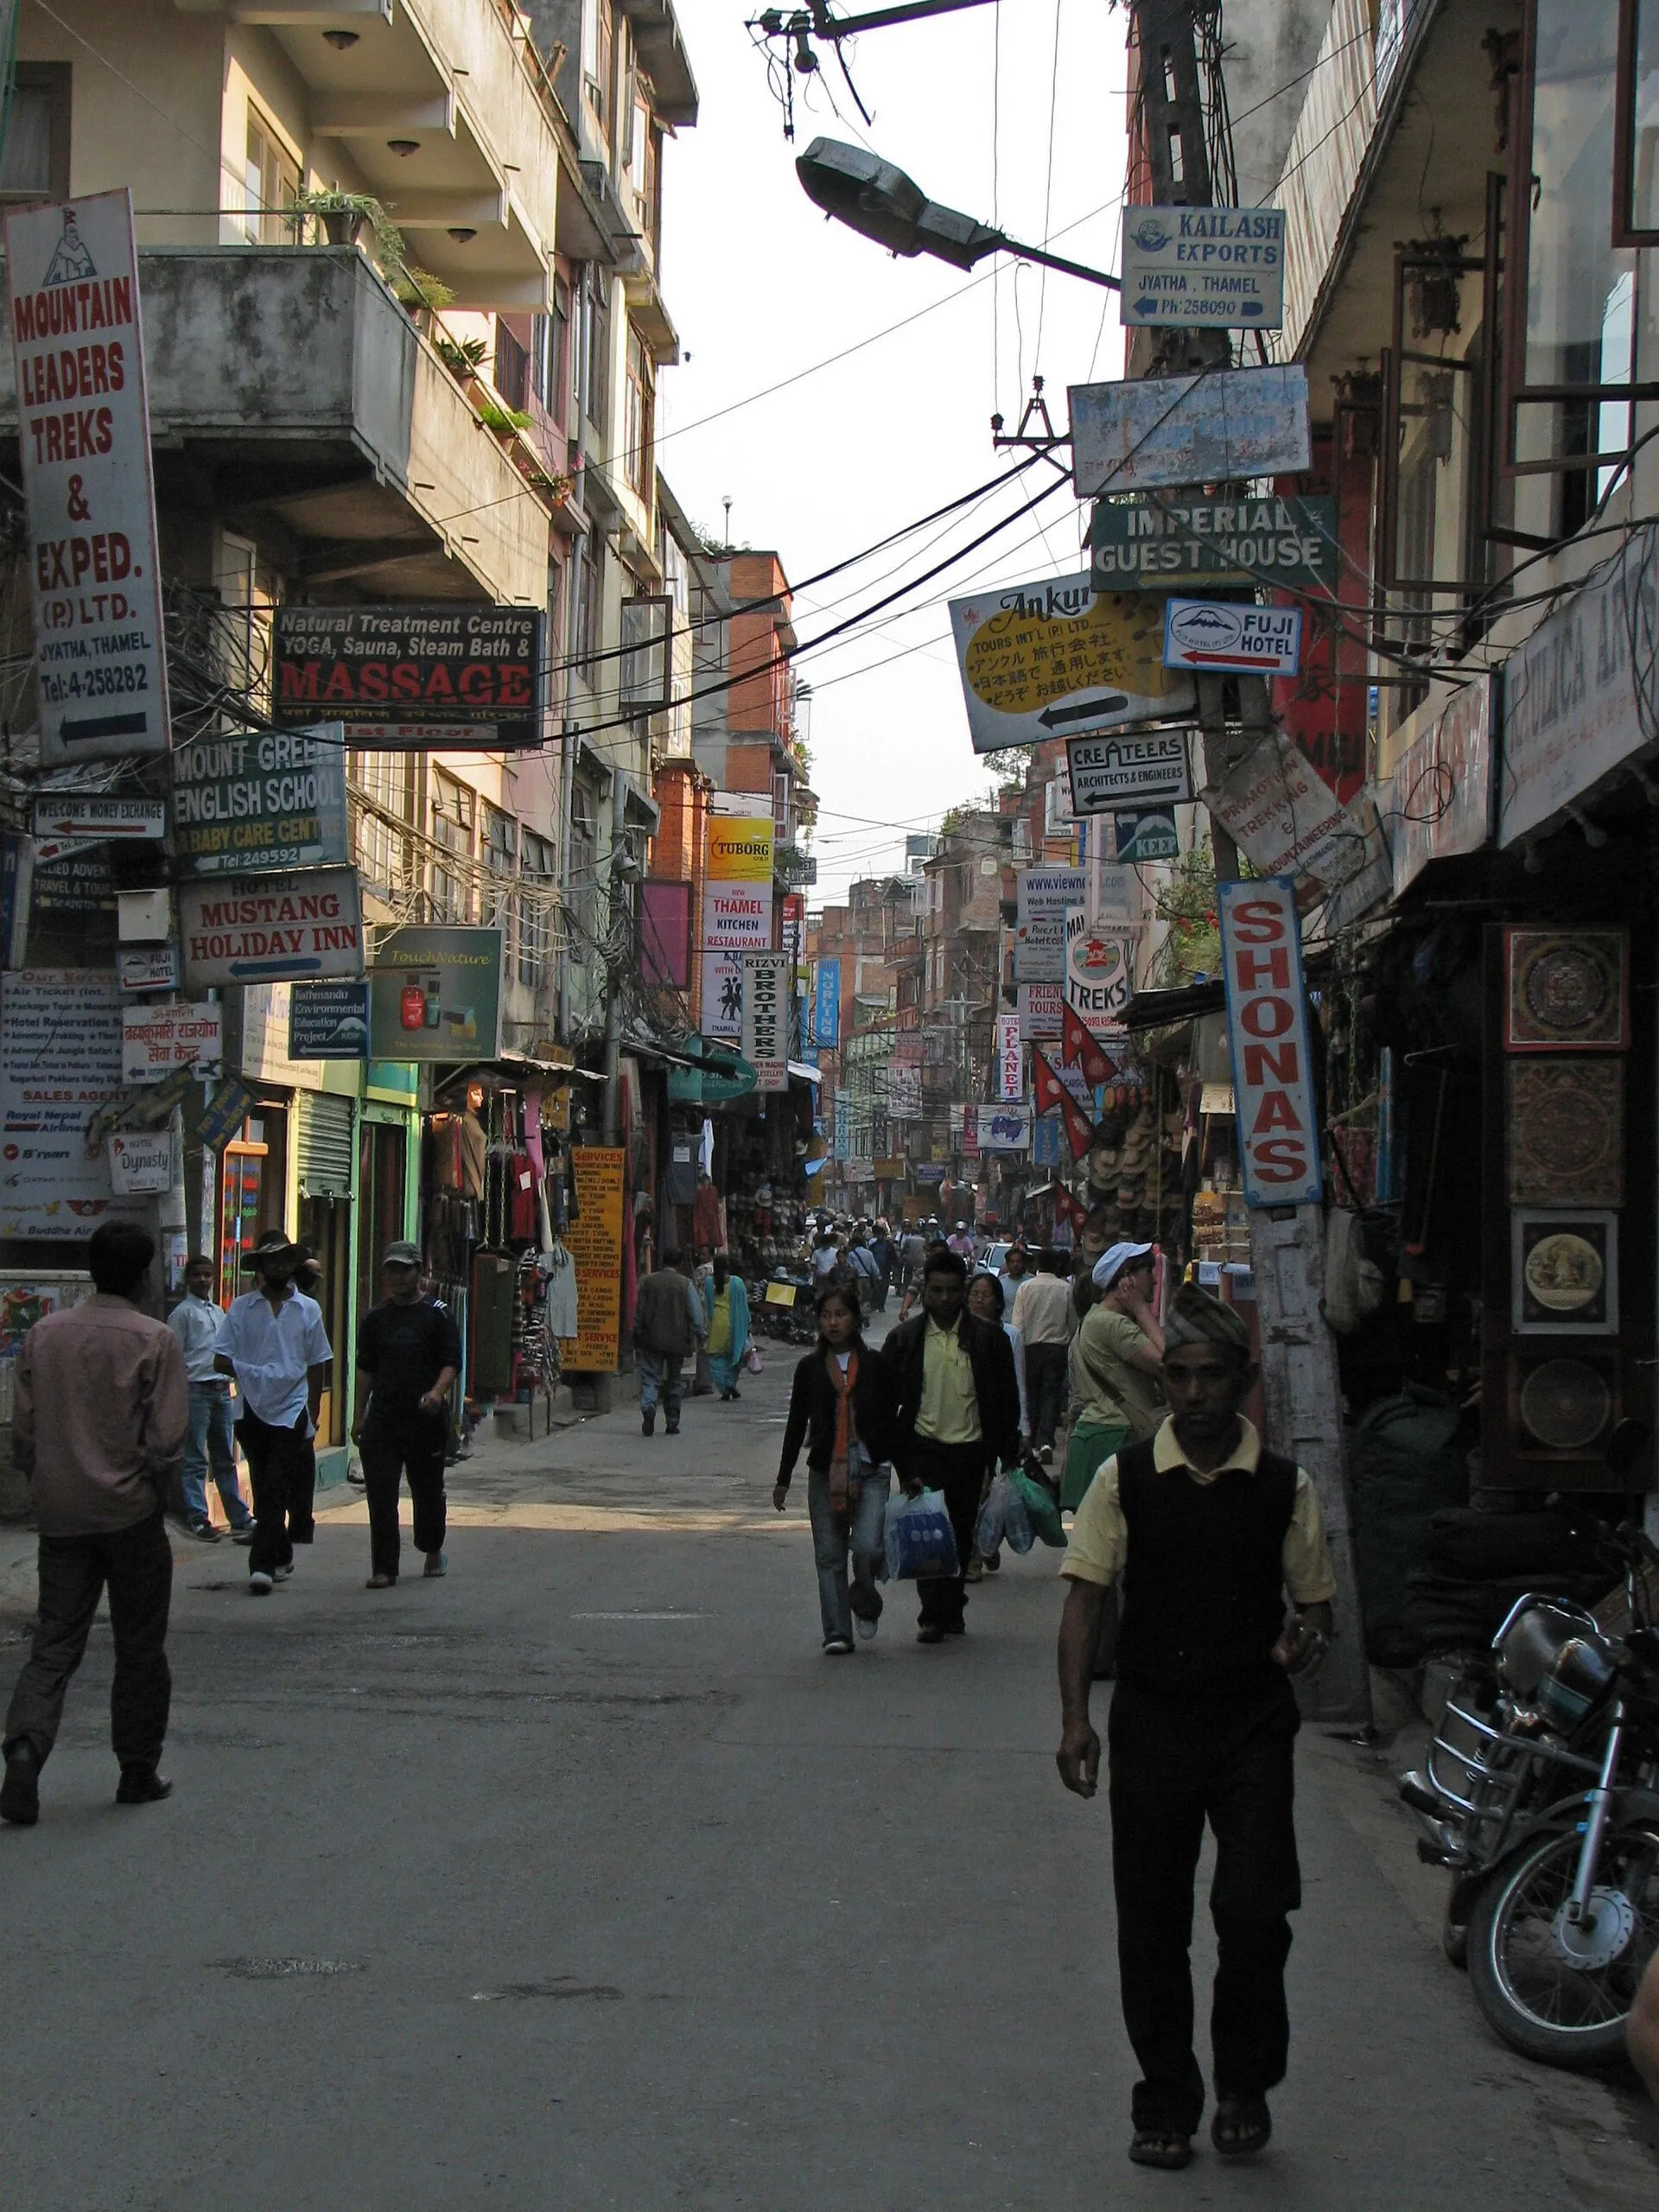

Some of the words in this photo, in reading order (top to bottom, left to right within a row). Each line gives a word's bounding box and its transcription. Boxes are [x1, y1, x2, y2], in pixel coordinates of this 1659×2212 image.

[1179, 214, 1281, 239] KAILASH
[1177, 244, 1277, 264] EXPORTS
[1202, 276, 1260, 294] THAMEL
[14, 276, 132, 344] MOUNTAIN
[22, 341, 125, 407] LEADERS
[31, 407, 114, 465] TREKS
[67, 474, 92, 522] &
[1127, 505, 1297, 537] IMPERIAL
[36, 531, 143, 592] EXPED.
[1095, 539, 1204, 574] GUEST
[1218, 536, 1323, 568] HOUSE
[79, 593, 137, 625] LTD.
[280, 613, 353, 633] Natural
[359, 614, 461, 633] Treatment
[467, 614, 533, 635] Centre
[1243, 614, 1293, 635] FUJI
[91, 632, 151, 655] THAMEL
[283, 636, 337, 660] YOGA,
[343, 635, 402, 659] Sauna,
[408, 636, 465, 658] Steam
[469, 638, 511, 658] Bath
[517, 638, 530, 658] &
[974, 636, 1012, 654] TOURS
[1241, 636, 1294, 656] HOTEL
[280, 660, 533, 706] MASSAGE
[398, 725, 474, 737] Floor
[175, 740, 250, 783] MOUNT
[1073, 738, 1182, 767] CREATEERS
[1077, 772, 1129, 789] ARCHITECTS
[1138, 766, 1183, 783] ENGINEERS
[175, 780, 262, 823] ENGLISH
[265, 772, 342, 813] SCHOOL
[38, 801, 86, 818] WELCOME
[89, 802, 118, 819] MONEY
[121, 802, 162, 820] EXCHANGE
[190, 826, 230, 853] BABY
[233, 822, 274, 848] CARE
[1263, 808, 1348, 876] MOUNTAINEERING
[718, 842, 769, 856] TUBORG
[35, 878, 70, 894] TRAVEL
[231, 876, 300, 897] HOTEL
[199, 893, 340, 929] MUSTANG
[713, 899, 763, 914] THAMEL
[716, 918, 759, 931] KITCHEN
[189, 929, 304, 962] HOLIDAY
[312, 925, 358, 951] INN
[707, 936, 766, 948] RESTAURANT
[149, 953, 171, 965] FUJI
[745, 958, 785, 969] RIZVI
[150, 966, 175, 978] HOTEL
[35, 987, 76, 996] Ticket
[296, 988, 348, 1001] Kathmandu
[1069, 976, 1128, 1011] TREKS
[294, 1002, 365, 1014] Environmental
[753, 969, 777, 1059] BROTHERS
[1028, 1001, 1063, 1014] TOURS
[11, 1017, 40, 1027] Hotel
[43, 1017, 110, 1027] Reservation
[294, 1018, 338, 1027] Education
[294, 1031, 327, 1045] Project
[1003, 1027, 1020, 1096] PLANET
[22, 1090, 74, 1101] SALES
[6, 1109, 41, 1122] Royal
[44, 1109, 82, 1122] Nepal
[122, 1150, 168, 1173] Dynasty
[574, 1150, 623, 1161] SERVICES
[28, 1225, 73, 1236] Buddha
[74, 1225, 93, 1236] Air
[582, 1268, 621, 1279] SERVICES
[584, 1333, 619, 1343] SERVICE
